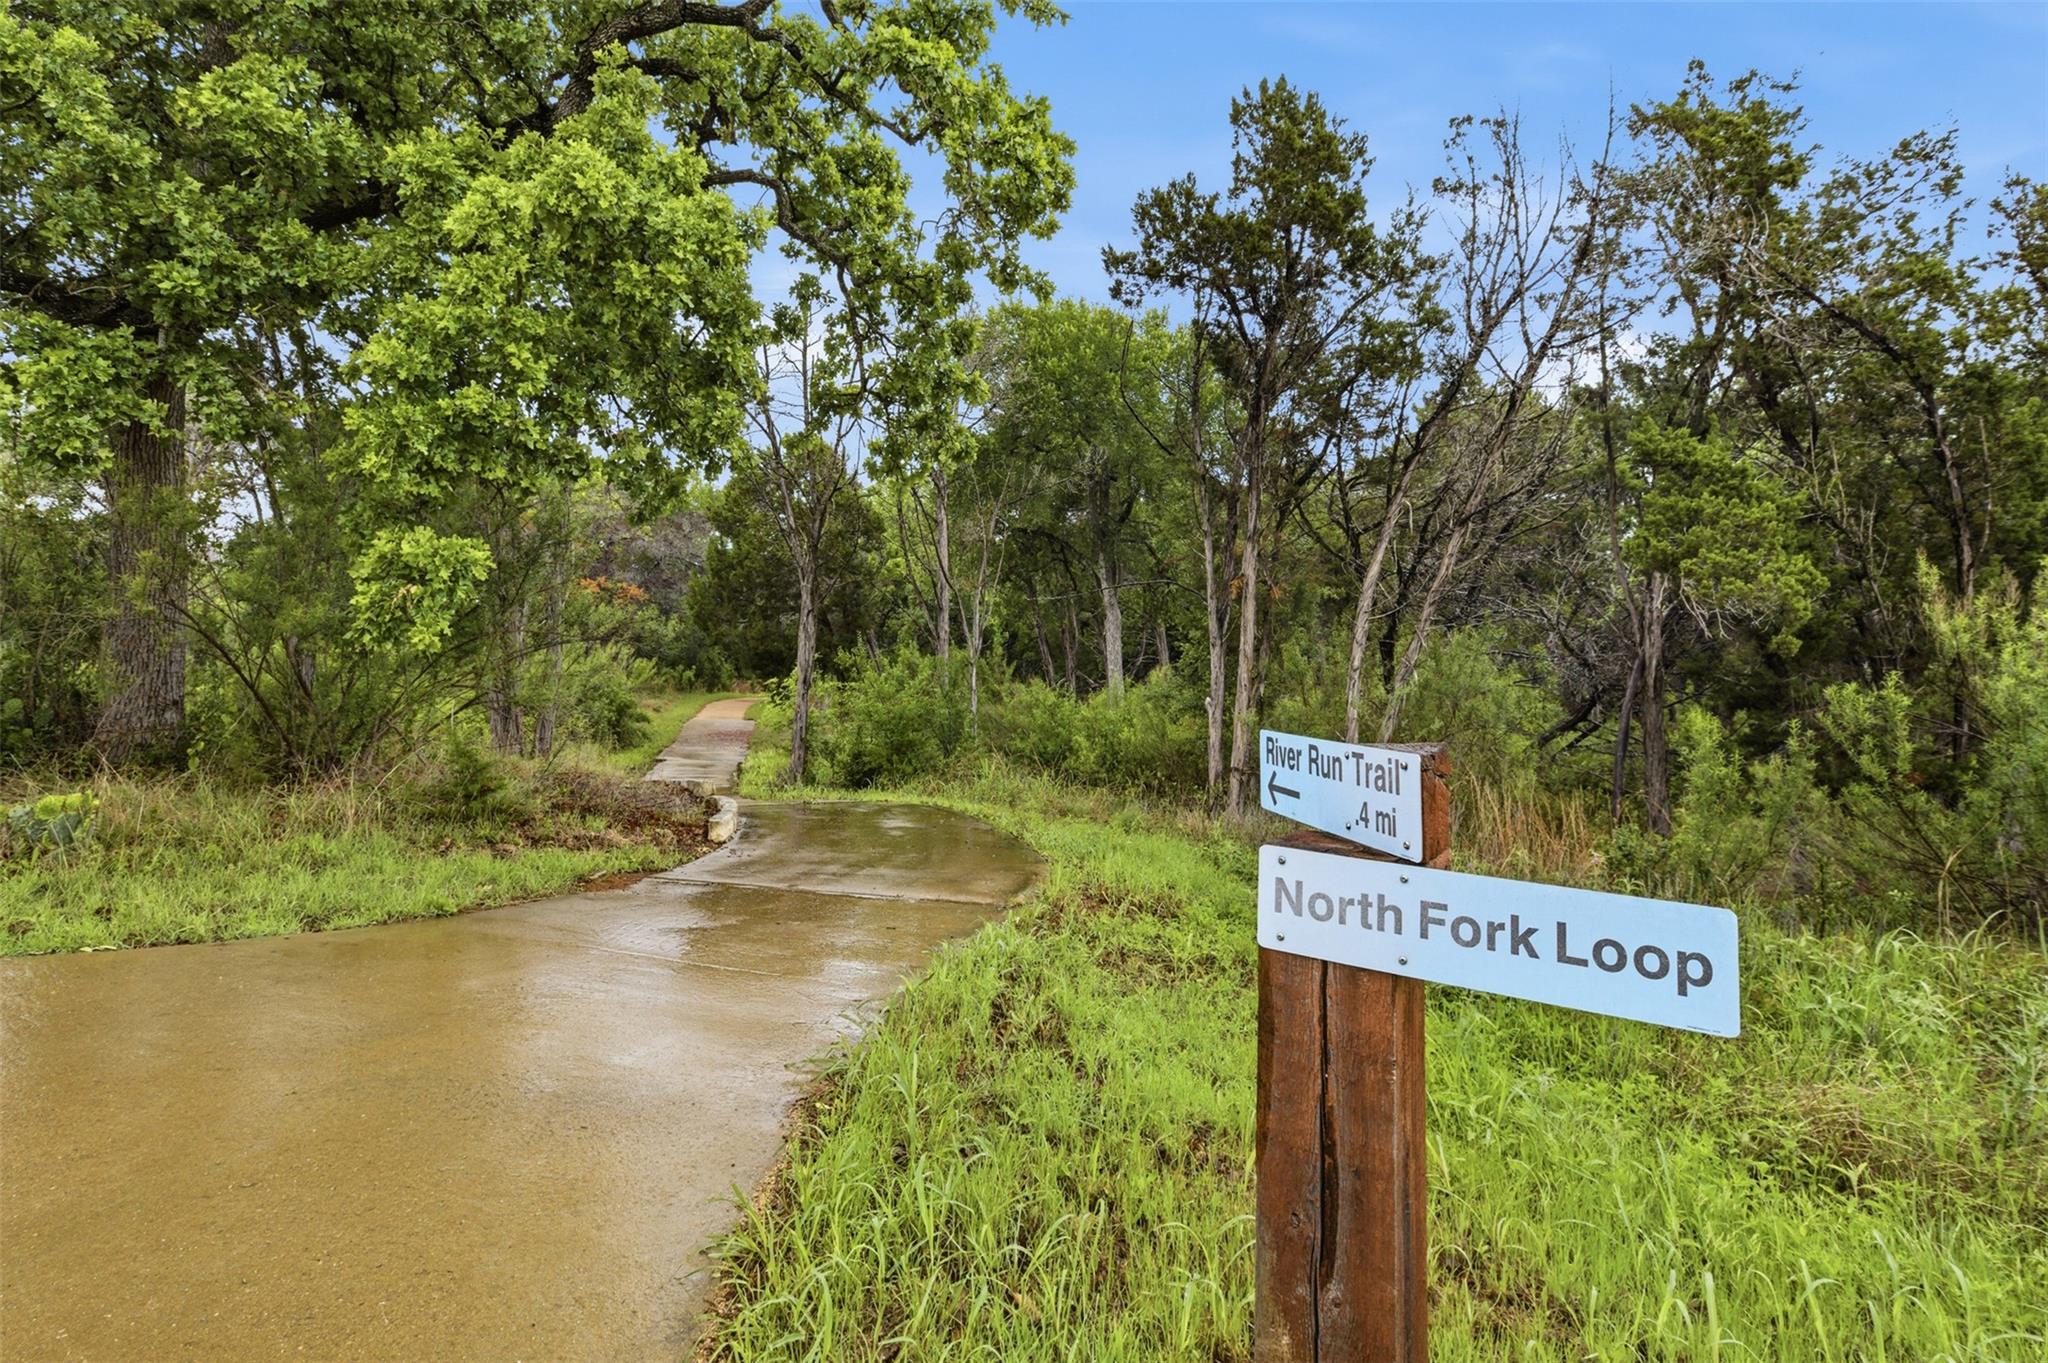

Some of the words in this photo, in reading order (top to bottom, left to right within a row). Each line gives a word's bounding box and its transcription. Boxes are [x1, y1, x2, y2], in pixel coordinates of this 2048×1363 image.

[1266, 737, 1302, 771] River
[1309, 745, 1343, 782] Run
[1352, 751, 1401, 795] Trail
[1356, 802, 1370, 828] .4
[1376, 808, 1397, 837] mi
[1274, 876, 1403, 935] North
[1421, 900, 1540, 958] Fork
[1558, 922, 1713, 996] Loop
